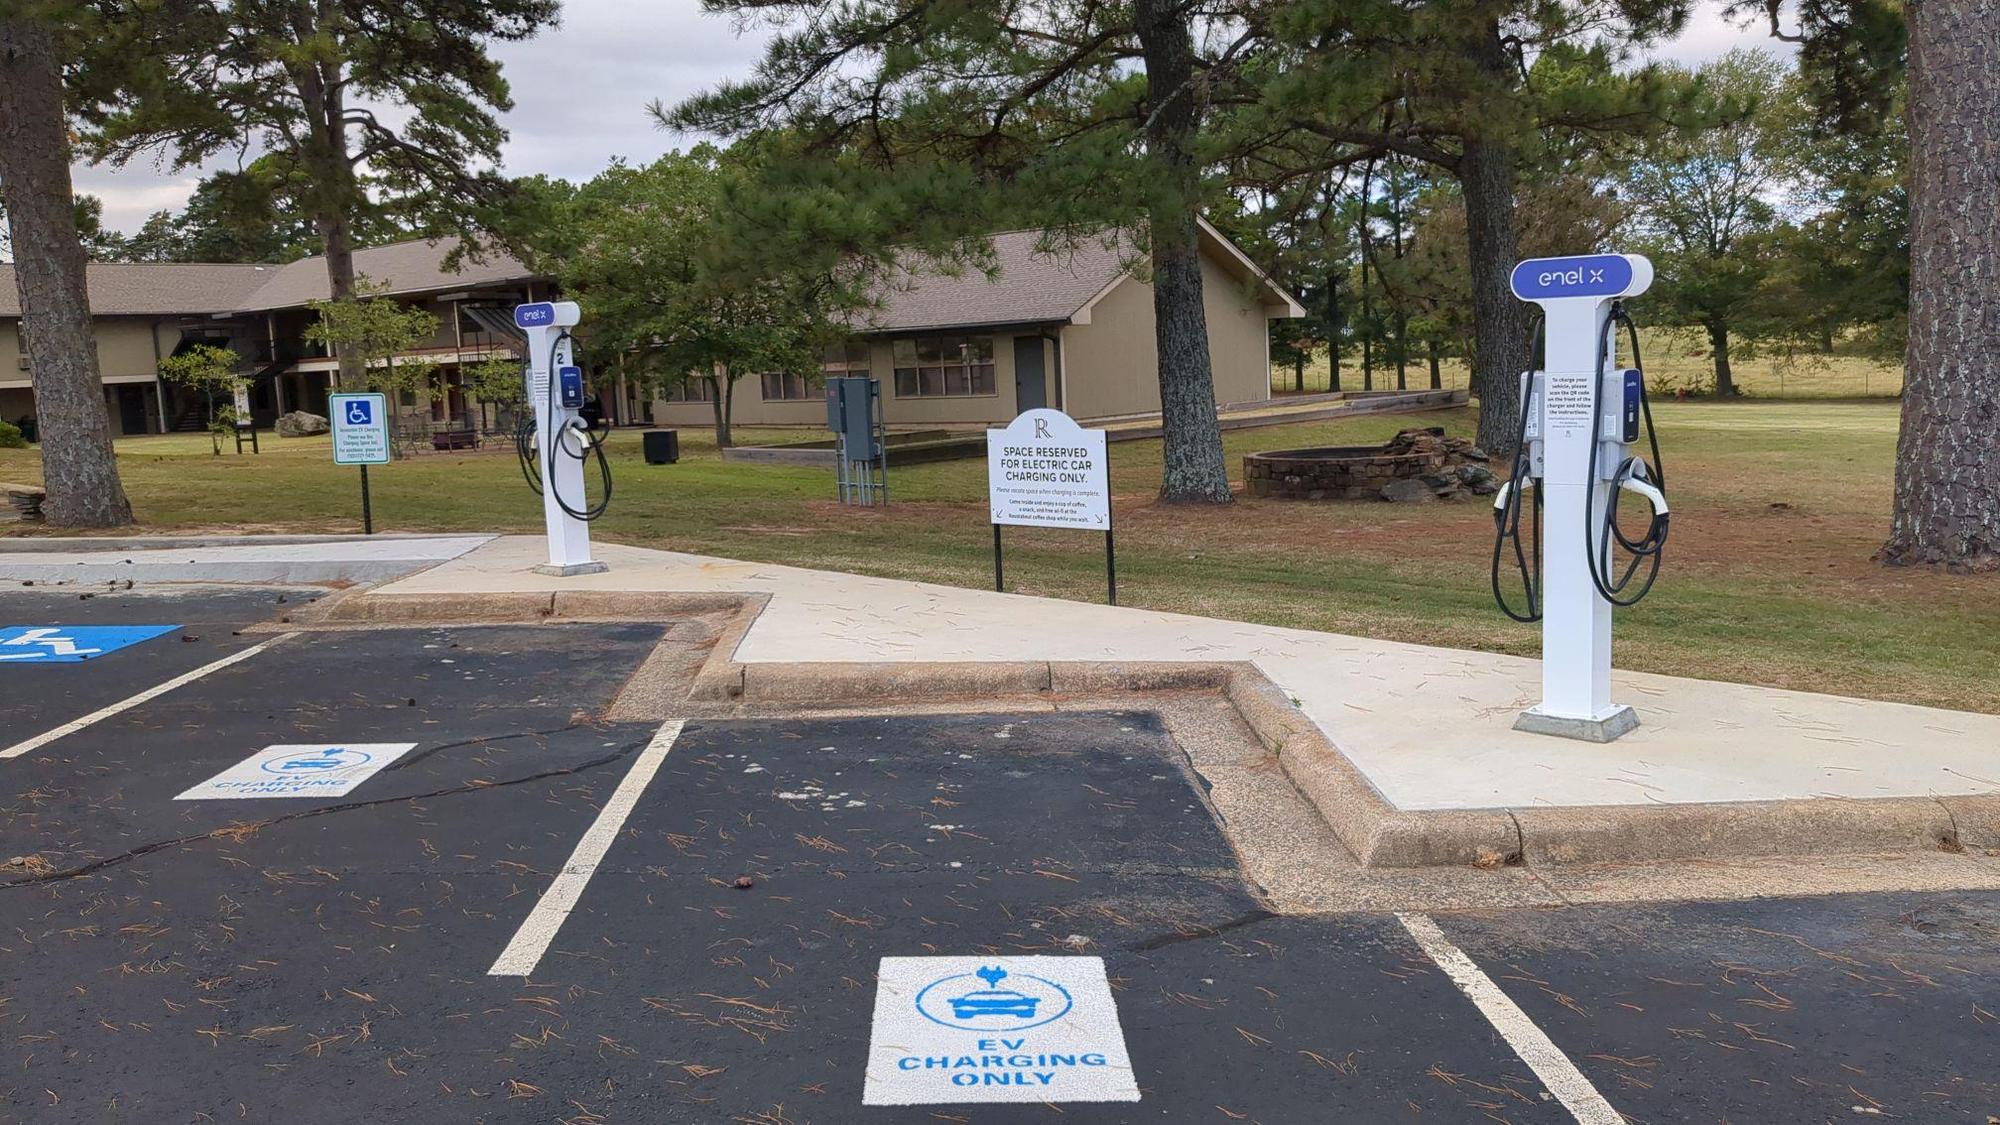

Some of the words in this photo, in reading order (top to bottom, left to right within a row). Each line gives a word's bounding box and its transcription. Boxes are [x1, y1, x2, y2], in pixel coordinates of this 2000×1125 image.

[1538, 266, 1584, 287] enel
[524, 310, 540, 320] enel
[557, 353, 564, 364] 2
[1034, 418, 1053, 439] R
[1003, 447, 1034, 457] SPACE
[1036, 447, 1088, 458] RESERVED
[1001, 459, 1020, 469] FOR
[1022, 459, 1068, 470] ELECTRIC
[1070, 460, 1092, 471] CAR
[1005, 471, 1057, 482] CHARGING
[1060, 473, 1088, 484] ONLY.
[214, 779, 349, 789] CHARGING
[977, 1038, 1025, 1051] EV
[897, 1053, 1107, 1071] CHARGING
[951, 1072, 1056, 1087] ONLY
